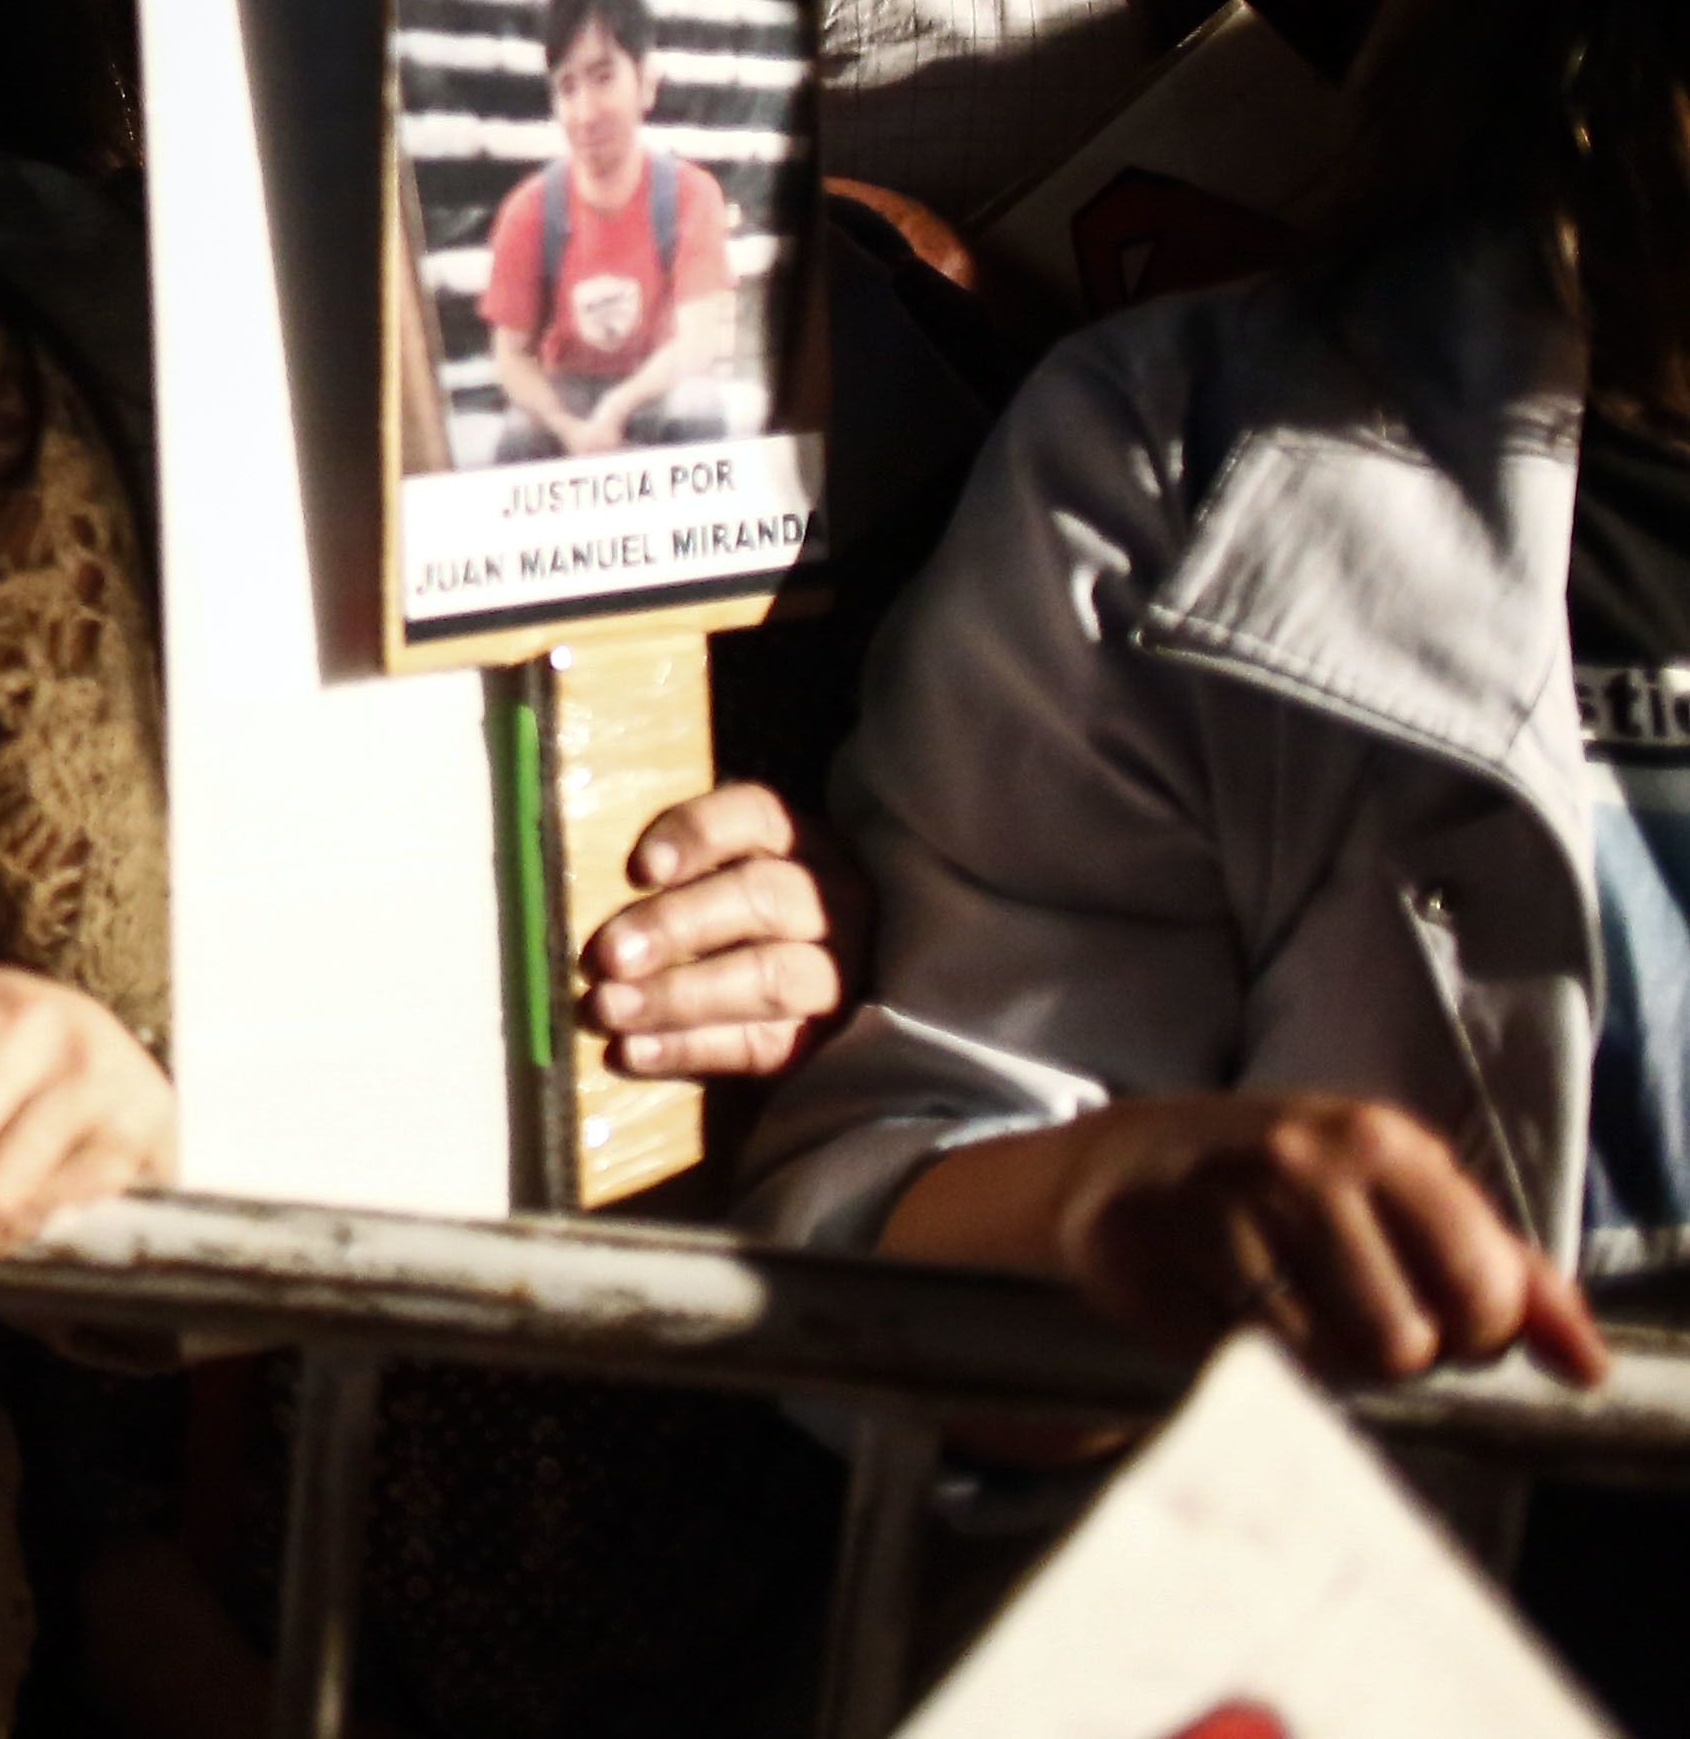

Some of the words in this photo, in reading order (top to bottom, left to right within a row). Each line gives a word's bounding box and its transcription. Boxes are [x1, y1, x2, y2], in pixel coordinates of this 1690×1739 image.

[502, 468, 656, 519] JUSTICIA
[671, 459, 737, 496] POR
[415, 554, 506, 597] JUAN
[519, 532, 658, 583] MANUEL
